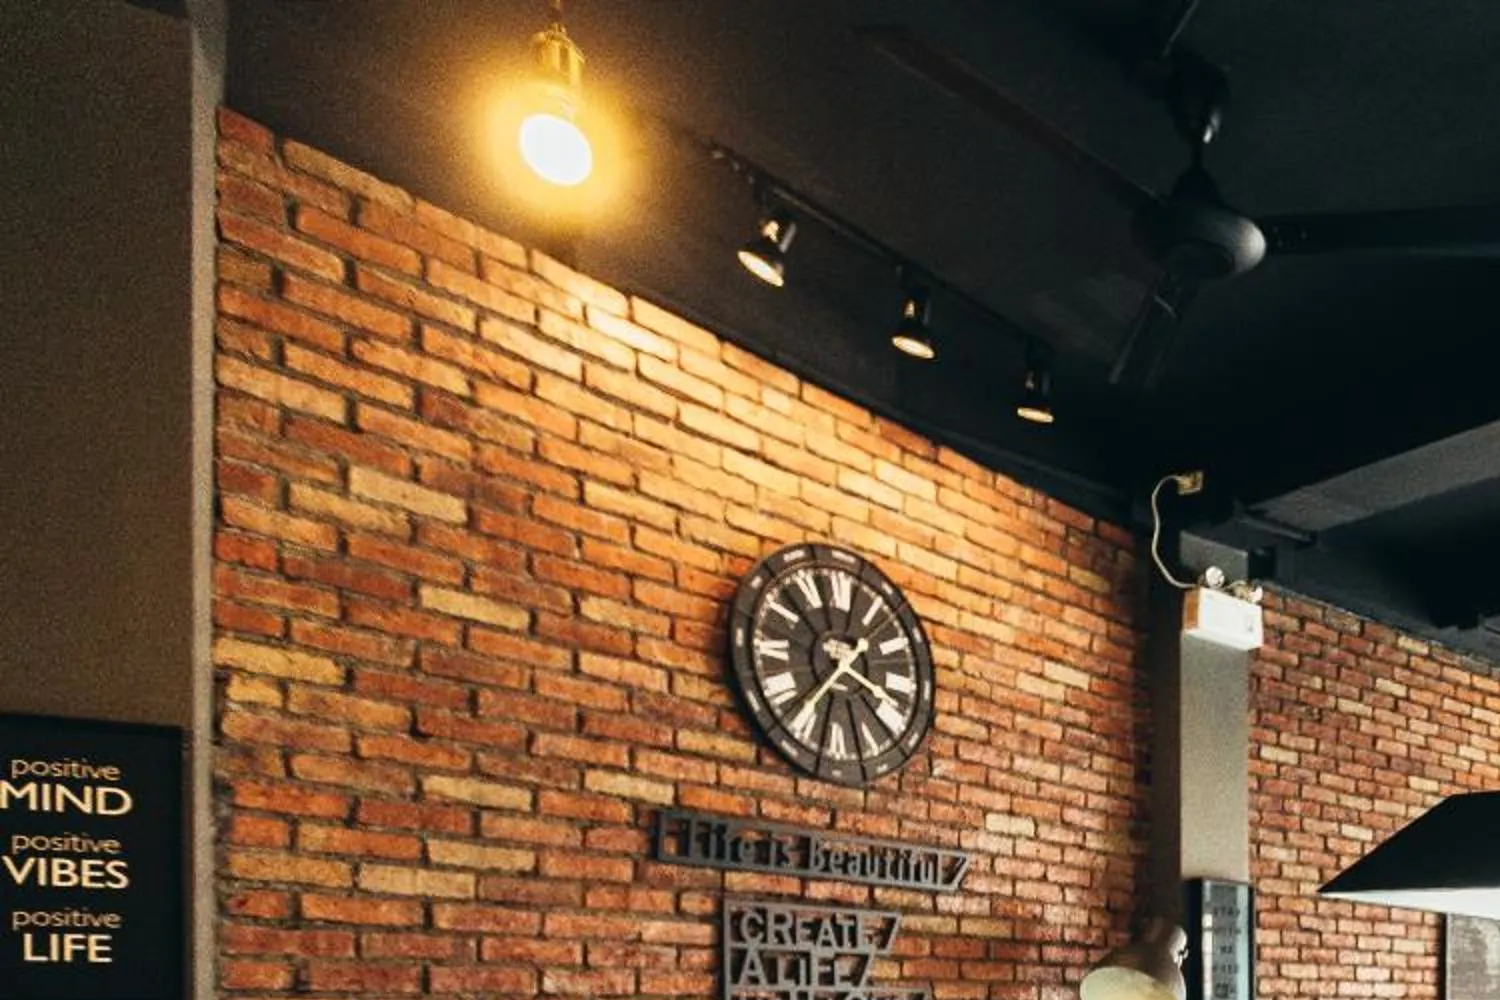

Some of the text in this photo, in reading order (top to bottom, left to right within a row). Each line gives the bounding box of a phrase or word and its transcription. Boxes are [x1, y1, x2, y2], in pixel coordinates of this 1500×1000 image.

[11, 758, 121, 780] positive
[0, 780, 133, 815] MIND
[11, 832, 122, 855] positive
[1, 855, 130, 890] VIBES
[11, 906, 122, 931] positive
[738, 905, 882, 950] CREATE
[22, 932, 114, 964] LIFE
[737, 948, 855, 989] A LIFE
